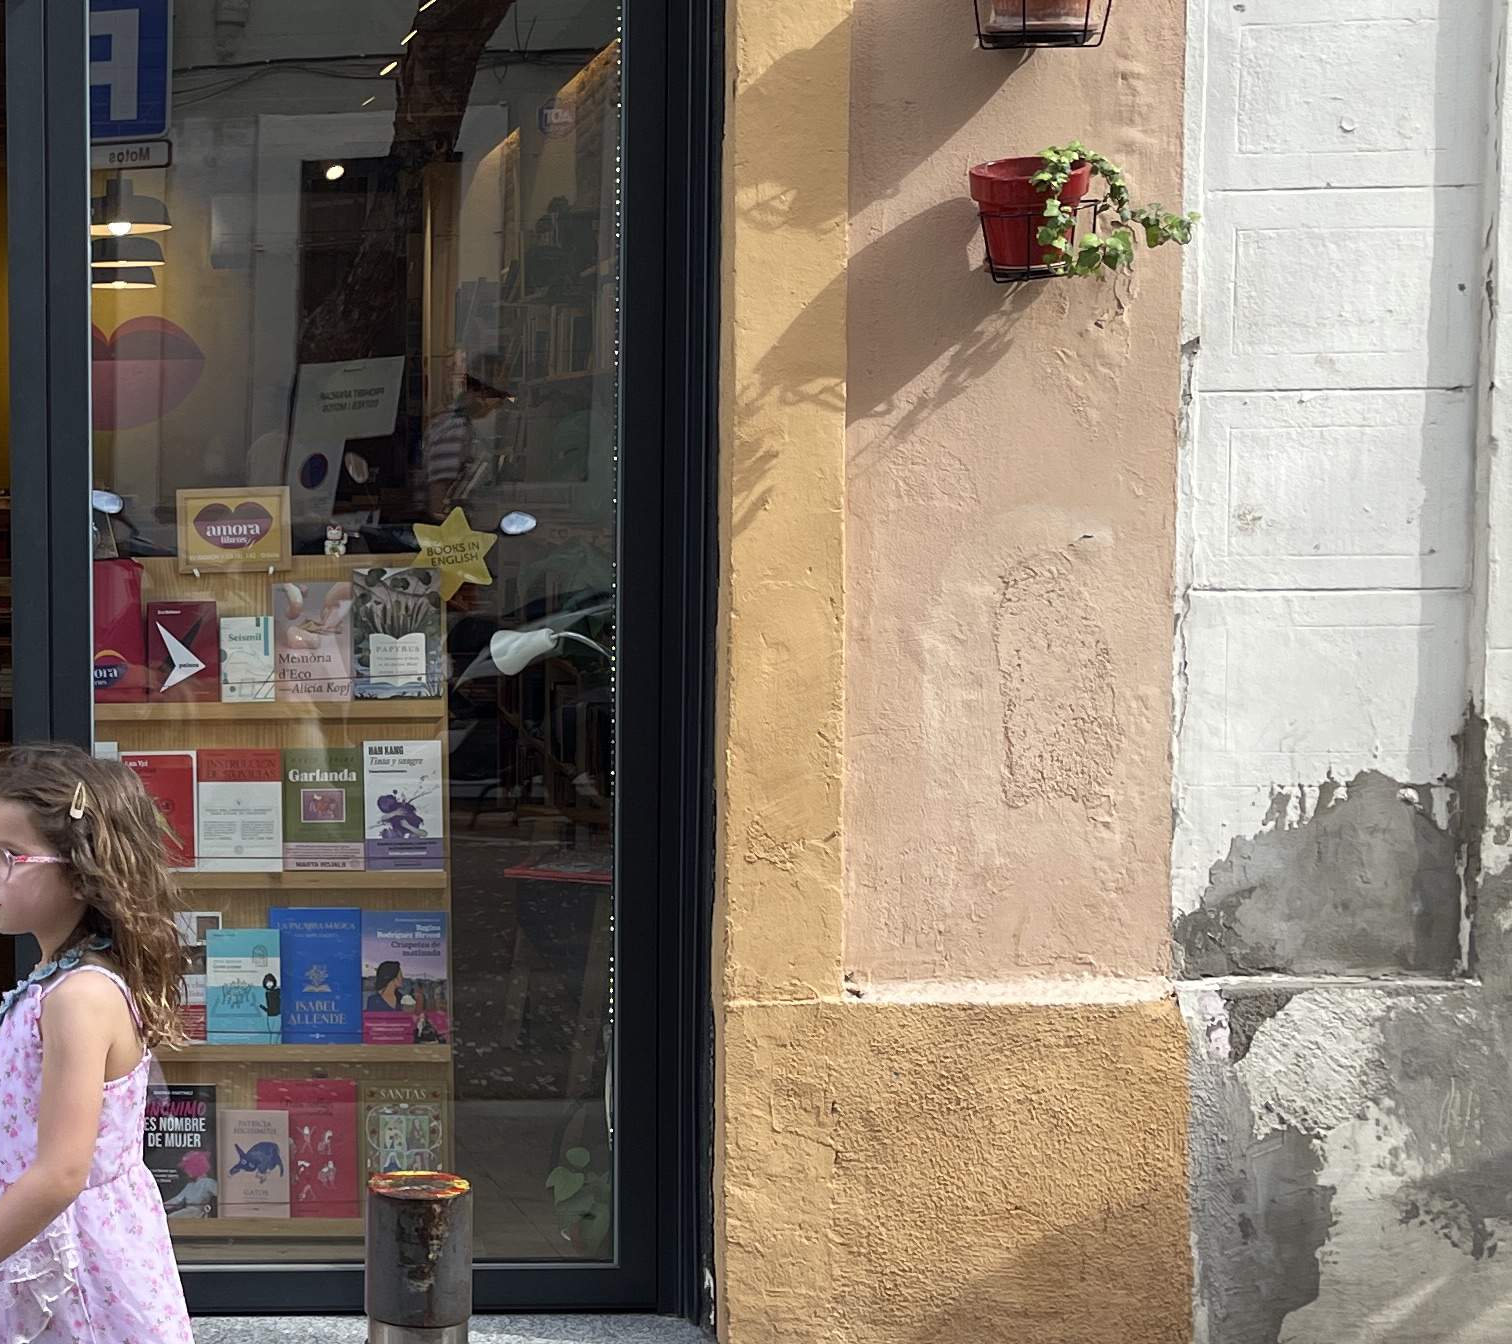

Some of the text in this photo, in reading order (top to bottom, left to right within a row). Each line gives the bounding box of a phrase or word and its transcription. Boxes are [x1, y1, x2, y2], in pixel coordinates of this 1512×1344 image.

[206, 523, 260, 537] amora
[427, 541, 480, 556] BOOKS IN
[431, 553, 479, 566] ENGLISH
[228, 633, 262, 642] Seismil
[279, 668, 311, 680] d'Eco
[326, 683, 350, 697] Kopf
[368, 745, 404, 755] HAN KANG
[369, 757, 390, 765] Tinta
[398, 758, 424, 767] sangre
[288, 768, 357, 782] Garlanda
[295, 1001, 338, 1012] ISABEL
[288, 1013, 347, 1025] ALLENDE
[379, 1089, 427, 1100] SANTAS
[144, 1117, 206, 1132] ES NOMBRE
[148, 1133, 201, 1148] DE MUJER
